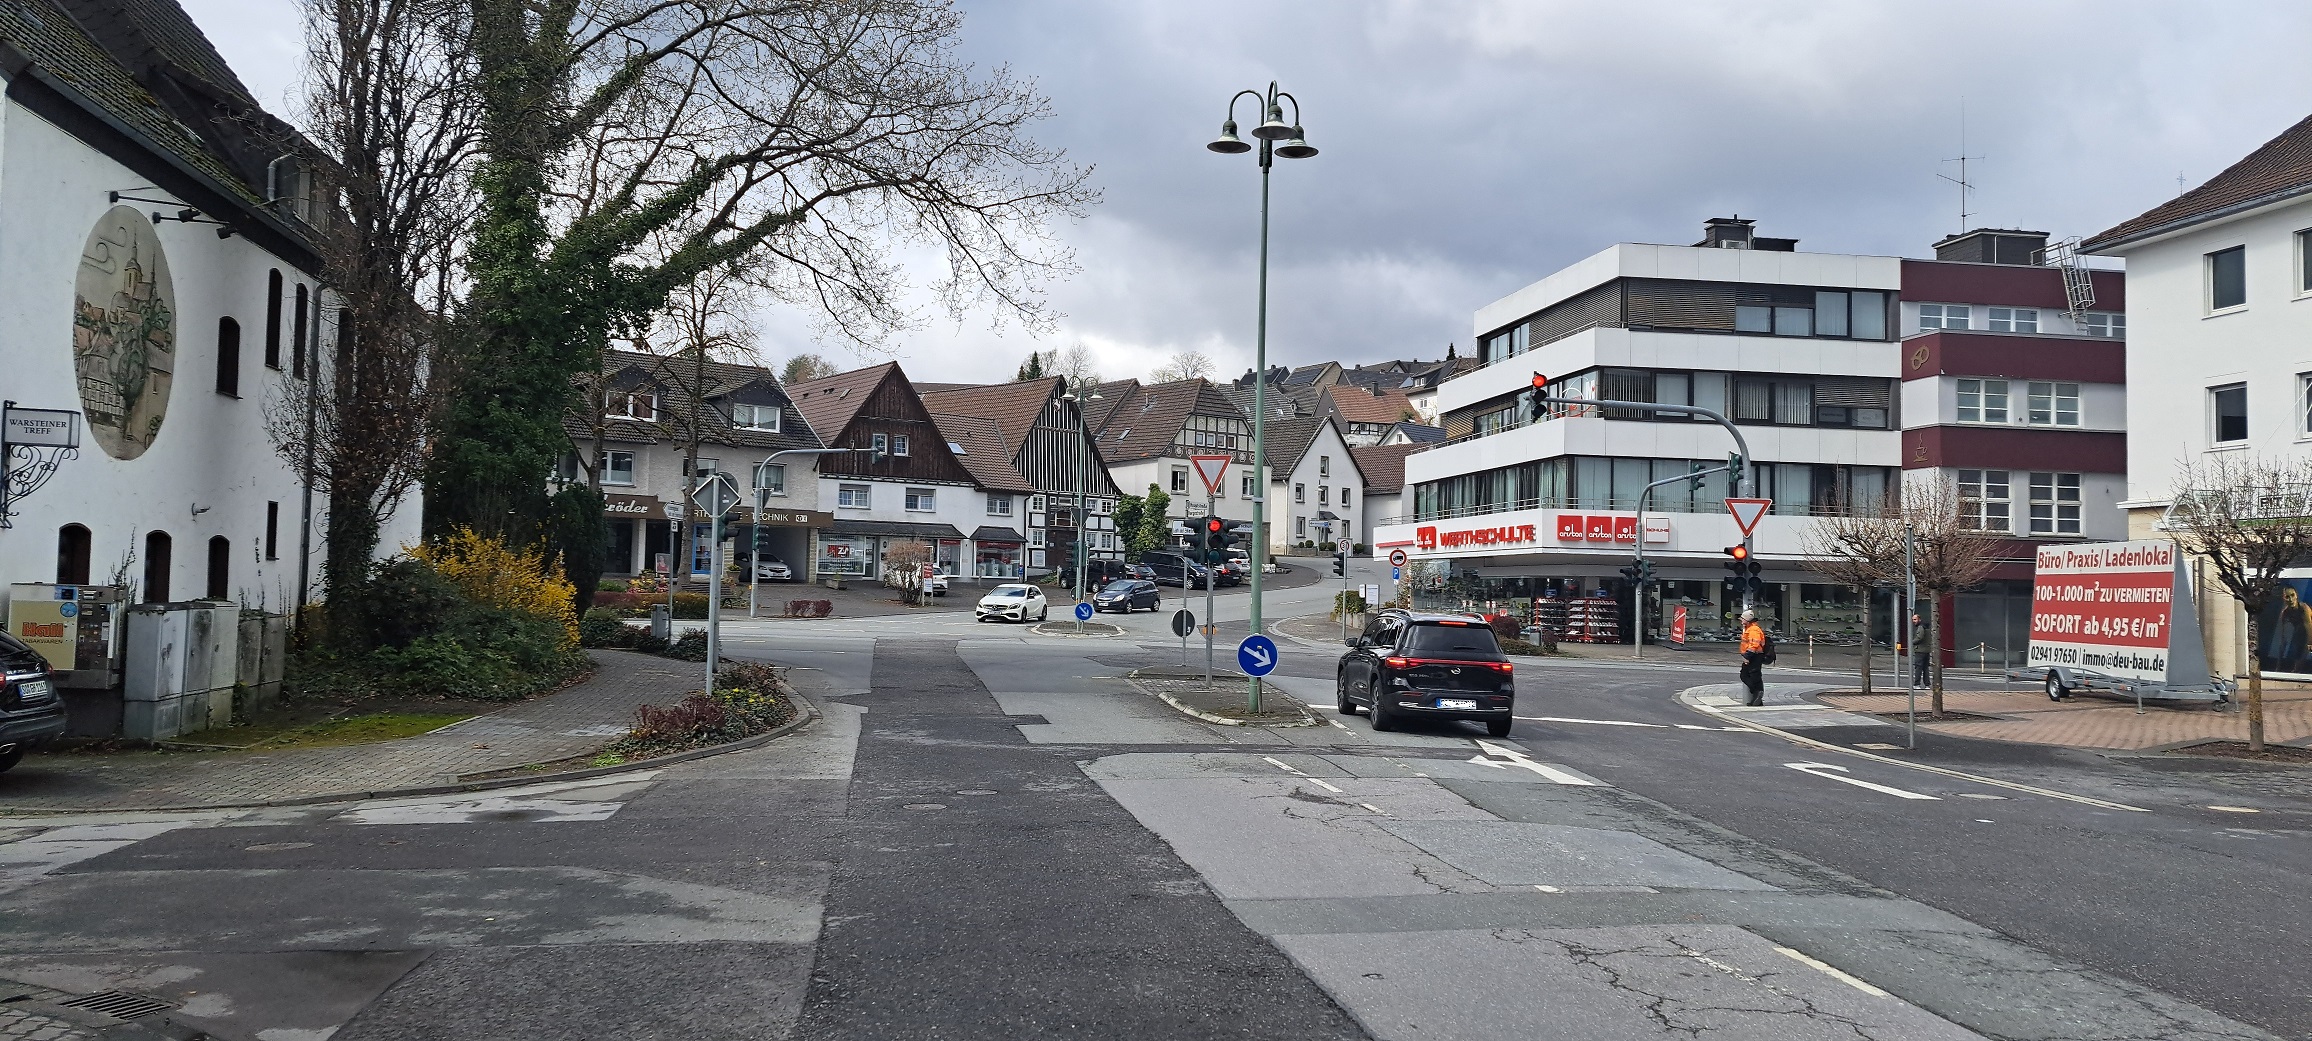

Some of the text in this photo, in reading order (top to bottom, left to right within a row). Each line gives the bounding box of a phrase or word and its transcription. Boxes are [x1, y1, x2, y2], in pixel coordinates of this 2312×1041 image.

[9, 419, 67, 428] WARSTEINER
[24, 427, 52, 435] TREFF
[1440, 524, 1536, 546] WERTHSCHULTE
[1559, 524, 1583, 538] ariston
[1589, 525, 1612, 539] ariston
[1617, 526, 1637, 540] aristo
[2038, 545, 2174, 569] Büro/ Praxis/ Ladenlokal
[2036, 586, 2083, 602] 100-1.000
[2100, 588, 2113, 603] ZU
[2114, 587, 2171, 603] VERMIETEN
[2034, 613, 2082, 633] SOFORT
[2084, 616, 2100, 635] ab
[2102, 617, 2129, 639] 4,95
[2031, 646, 2165, 672] 02941 97650 immo@deu-bau.de
